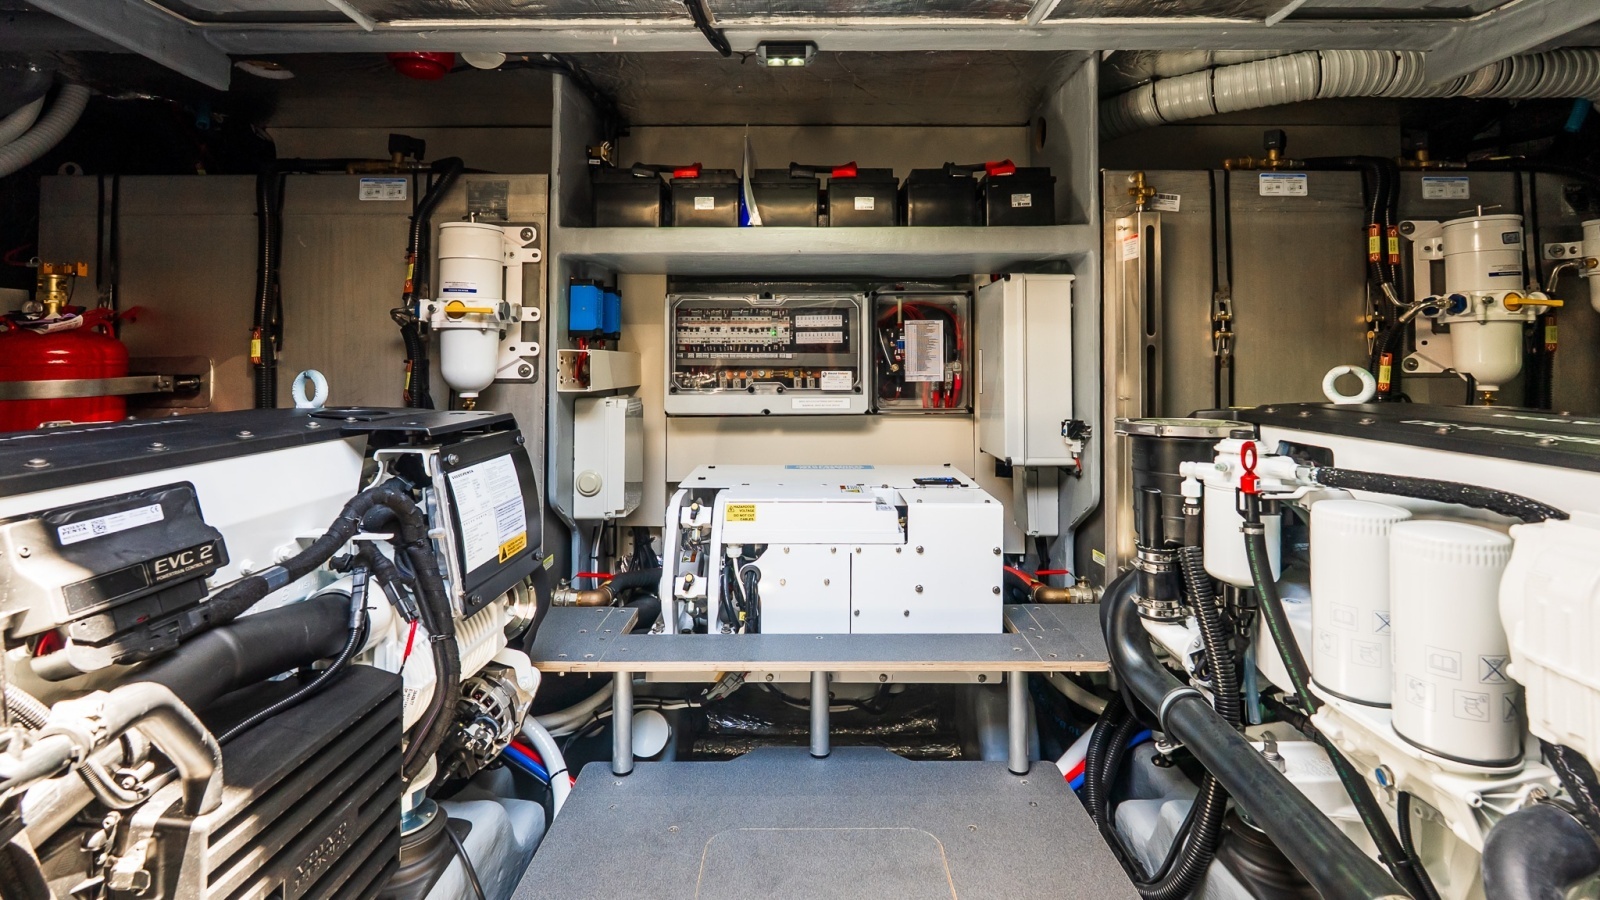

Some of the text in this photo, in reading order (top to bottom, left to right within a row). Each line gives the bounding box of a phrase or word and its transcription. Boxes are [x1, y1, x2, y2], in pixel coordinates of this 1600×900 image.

[62, 523, 86, 532] VOLVO
[62, 526, 87, 536] PENTA
[154, 544, 213, 575] EVC 2
[156, 568, 185, 581] POWERTRAIN
[184, 561, 204, 572] CONTROL
[295, 822, 347, 874] VOLVO
[293, 835, 347, 893] PENTA
